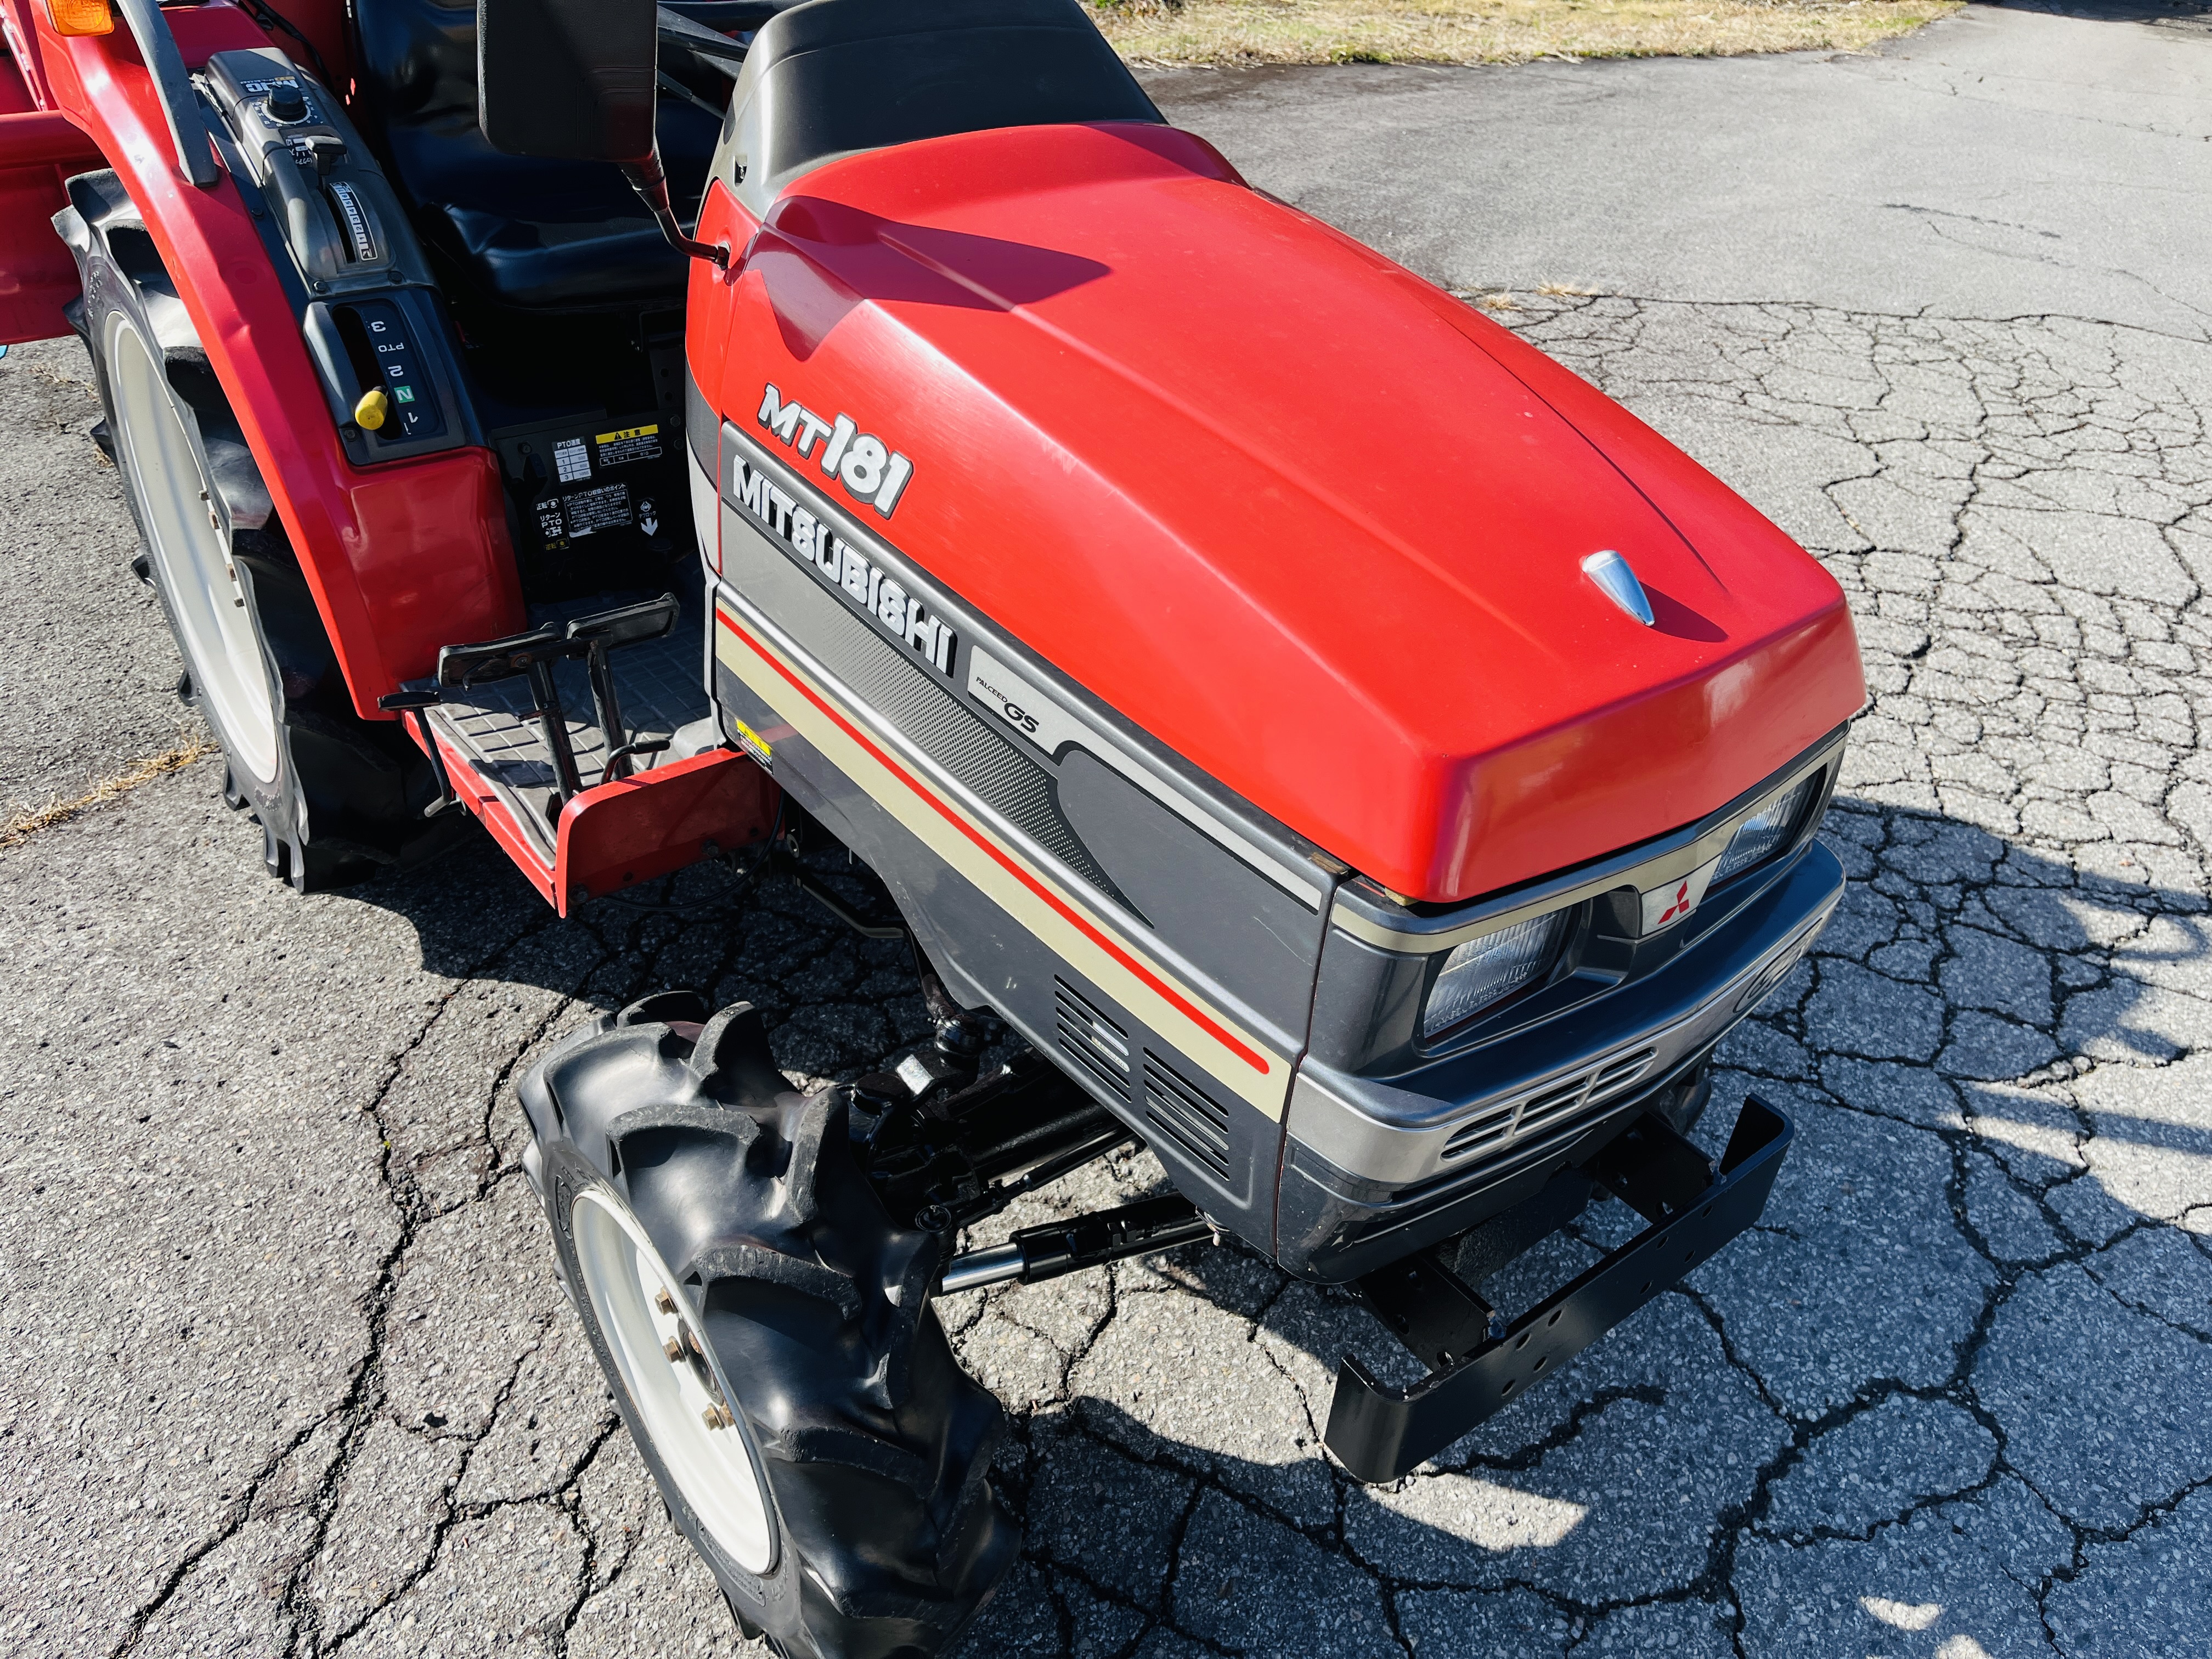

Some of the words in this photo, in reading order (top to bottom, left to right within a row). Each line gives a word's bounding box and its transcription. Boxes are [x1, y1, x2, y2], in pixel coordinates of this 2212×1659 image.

[370, 321, 386, 332] 3
[378, 342, 404, 352] PTO
[388, 365, 403, 377] 2
[396, 389, 413, 401] N
[408, 412, 418, 423] 1
[758, 382, 913, 520] MT181
[540, 512, 561, 522] リターン
[541, 518, 562, 528] PTO
[733, 454, 958, 678] MITSUBISHI
[976, 676, 1008, 703] PALCEED
[1004, 703, 1040, 733] GS
